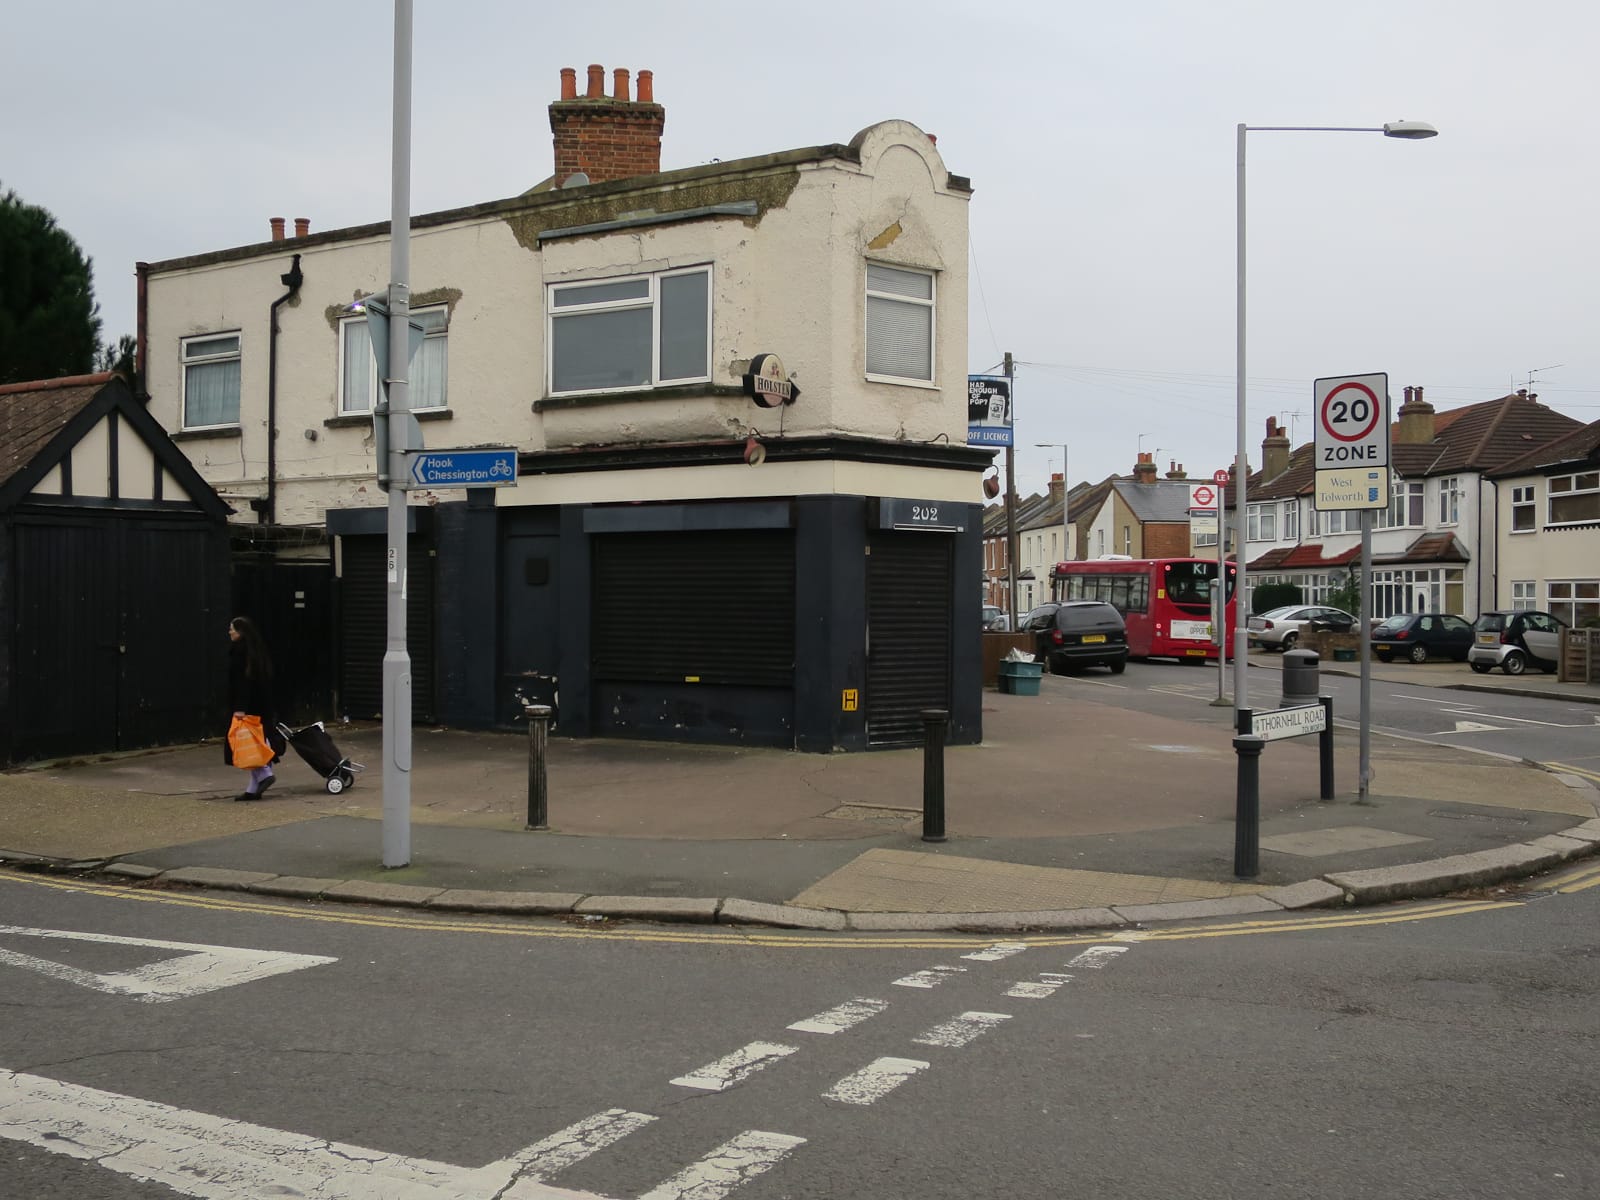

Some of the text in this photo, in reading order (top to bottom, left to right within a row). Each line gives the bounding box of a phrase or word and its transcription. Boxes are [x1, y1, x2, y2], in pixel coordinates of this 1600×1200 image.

[757, 377, 790, 397] HOLSTEN
[1331, 399, 1369, 423] 20
[968, 431, 1009, 441] OFF LICENCE
[1324, 445, 1377, 461] ZONE
[427, 458, 453, 468] Hook
[427, 469, 488, 481] Chessington
[1331, 478, 1353, 488] West
[1320, 491, 1364, 502] Tolworth
[912, 505, 938, 521] 202
[1193, 563, 1207, 575] K1
[844, 691, 856, 709] H
[1260, 713, 1302, 731] THORNHILL
[1304, 709, 1325, 724] ROAD
